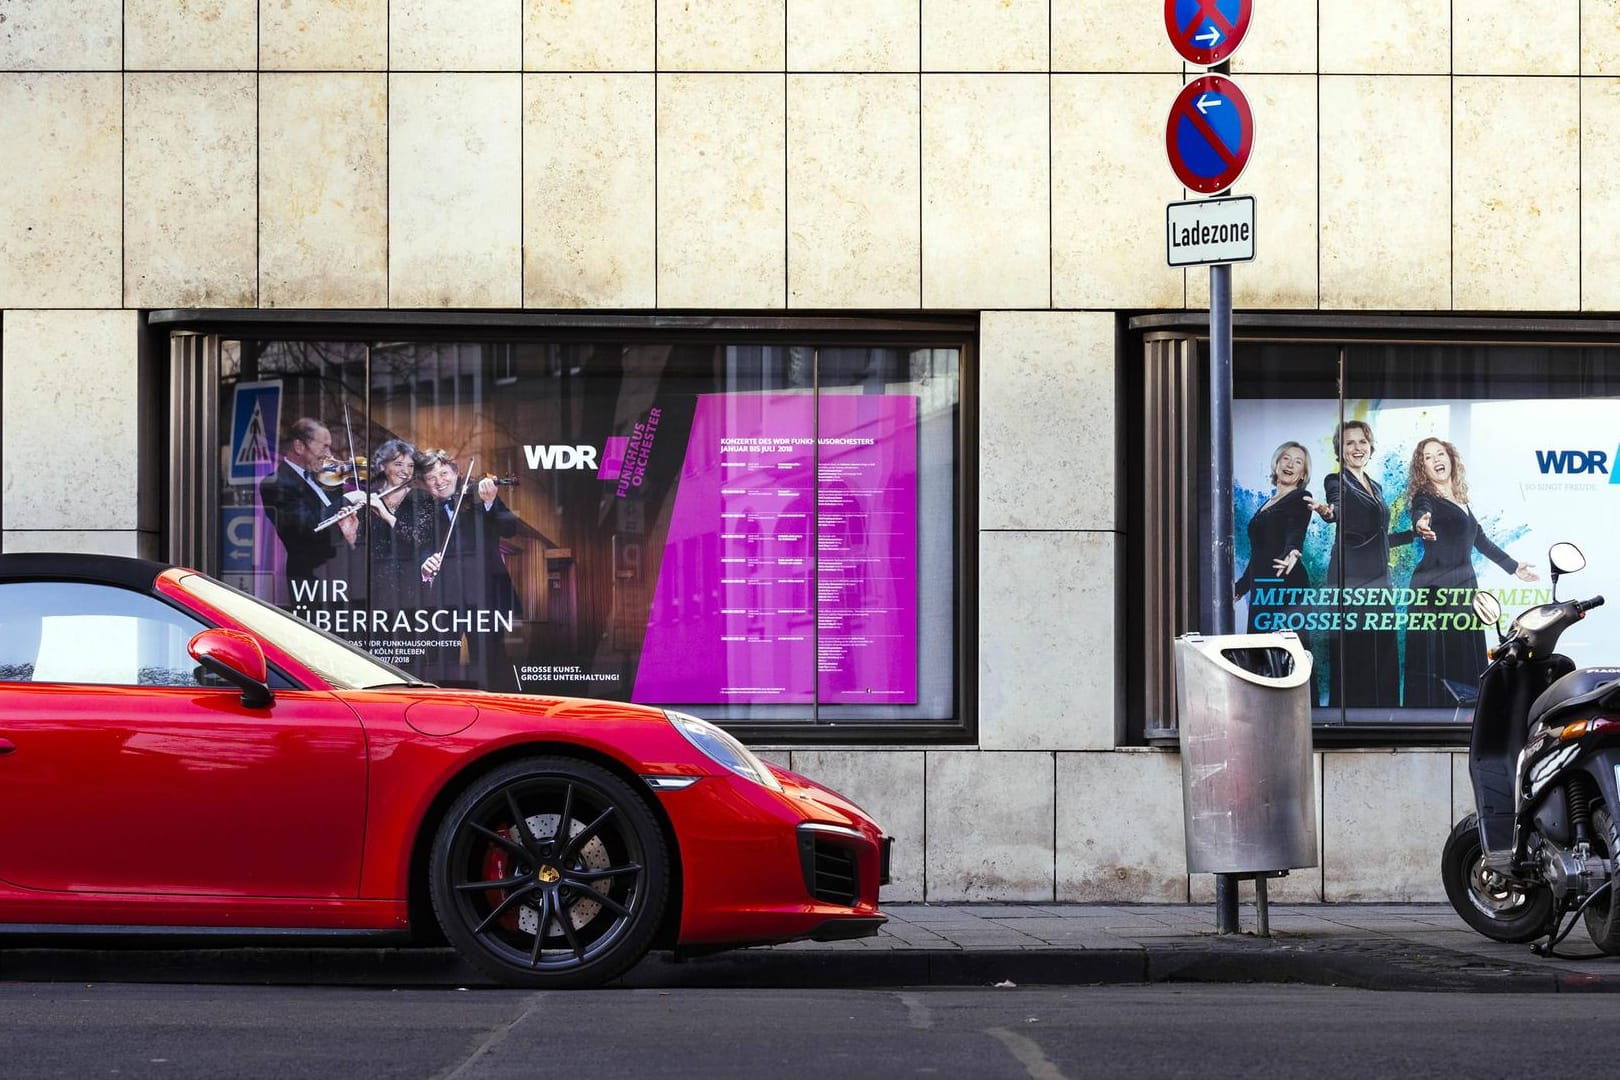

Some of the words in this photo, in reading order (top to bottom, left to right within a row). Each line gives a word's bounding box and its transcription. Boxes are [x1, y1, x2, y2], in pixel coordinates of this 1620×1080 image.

[1172, 220, 1249, 247] Ladezone
[632, 408, 662, 486] ORCHESTER
[720, 437, 757, 446] KONZERTE
[758, 437, 772, 446] DES
[773, 437, 790, 446] WDR
[720, 445, 748, 455] JANUAR
[750, 445, 760, 453] BIS
[761, 445, 775, 455] JULI
[778, 445, 793, 453] 2018
[523, 445, 598, 470] WDR
[616, 423, 645, 497] FUNKHAUS
[1535, 450, 1609, 474] WDR
[291, 579, 349, 602] WIR
[1252, 588, 1429, 606] MITREISSENDE
[1434, 588, 1552, 606] STIMEN
[1254, 612, 1358, 631] GROSSES
[1362, 612, 1509, 631] REPERTOIE
[374, 646, 394, 656] KÖLN
[394, 648, 426, 656] ERLEBEN
[382, 640, 462, 648] FUNKHAUSORCHESTER
[376, 656, 410, 665] 017/2018
[521, 666, 552, 674] GROSSE
[553, 666, 582, 674] KUNST.
